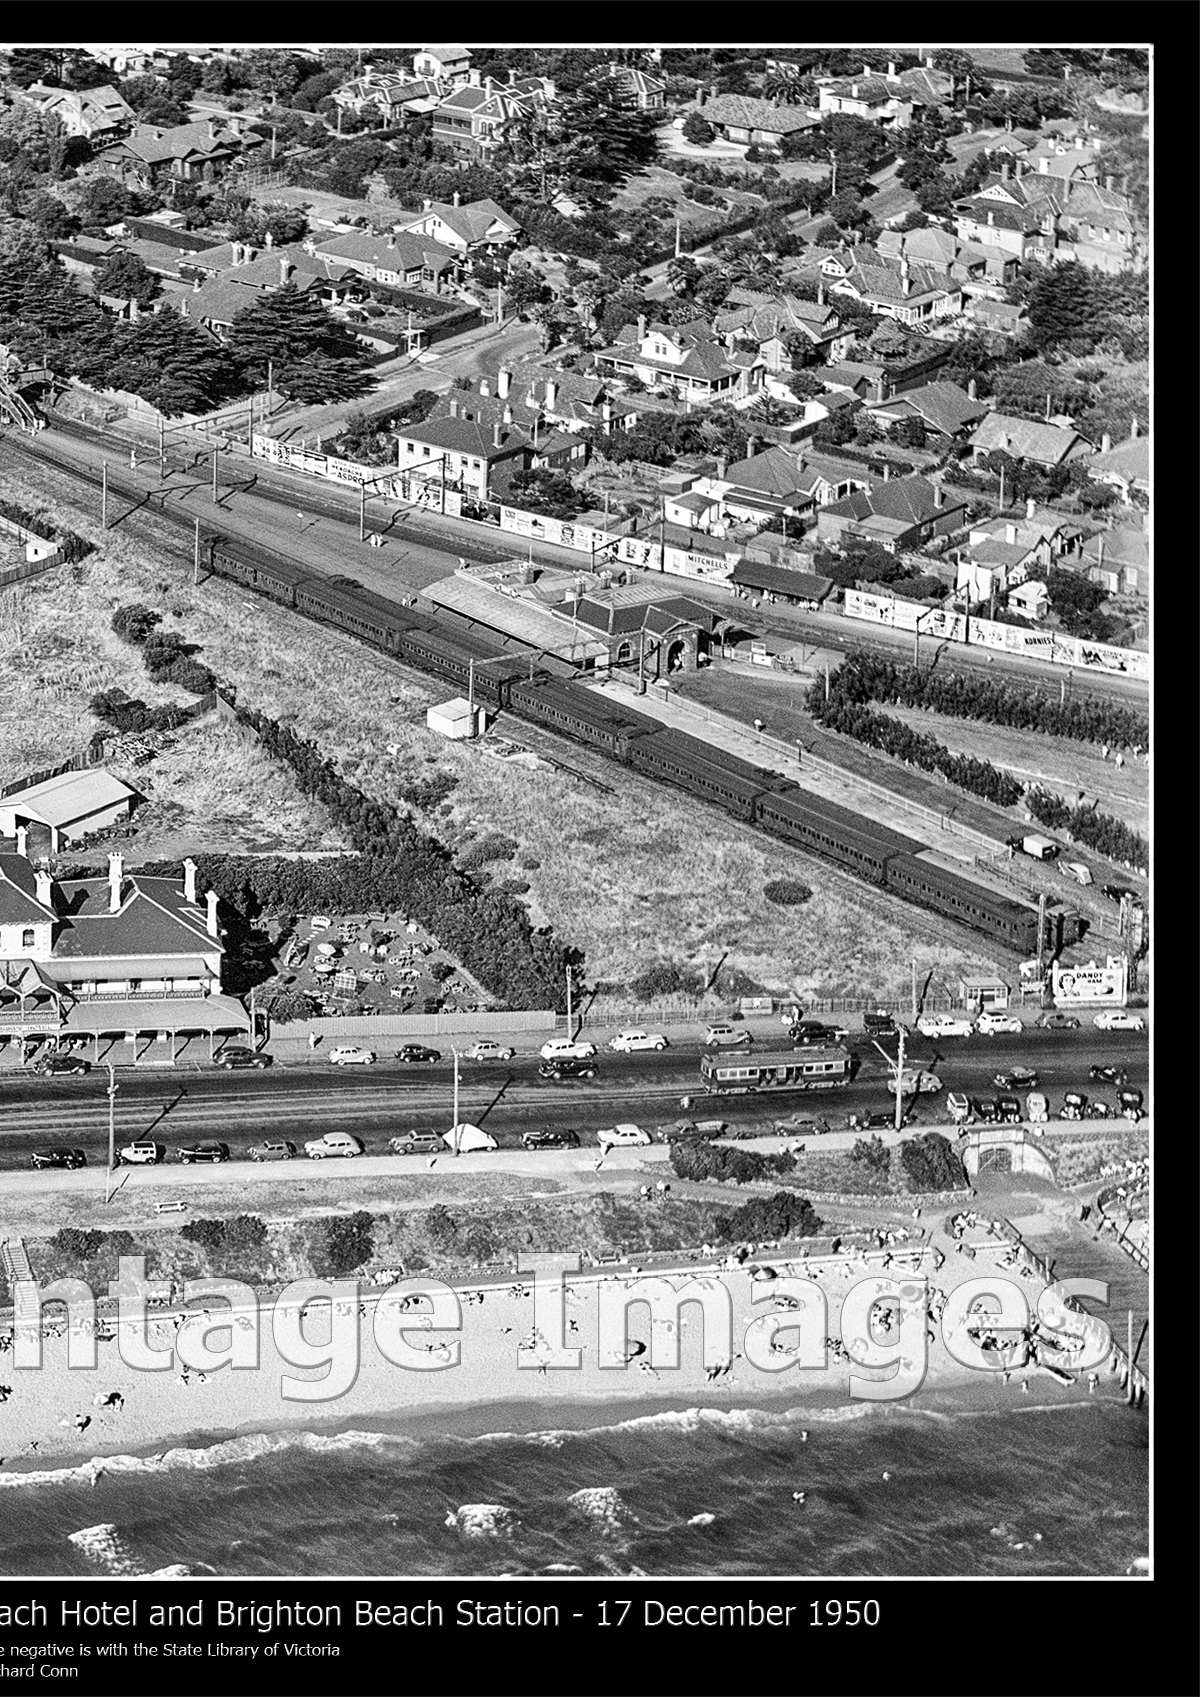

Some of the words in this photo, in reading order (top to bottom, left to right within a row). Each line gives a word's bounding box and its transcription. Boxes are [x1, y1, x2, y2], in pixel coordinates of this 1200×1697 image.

[331, 465, 362, 477] HEADACHE
[337, 472, 364, 485] ASPRO
[688, 554, 728, 570] MITCHELLS
